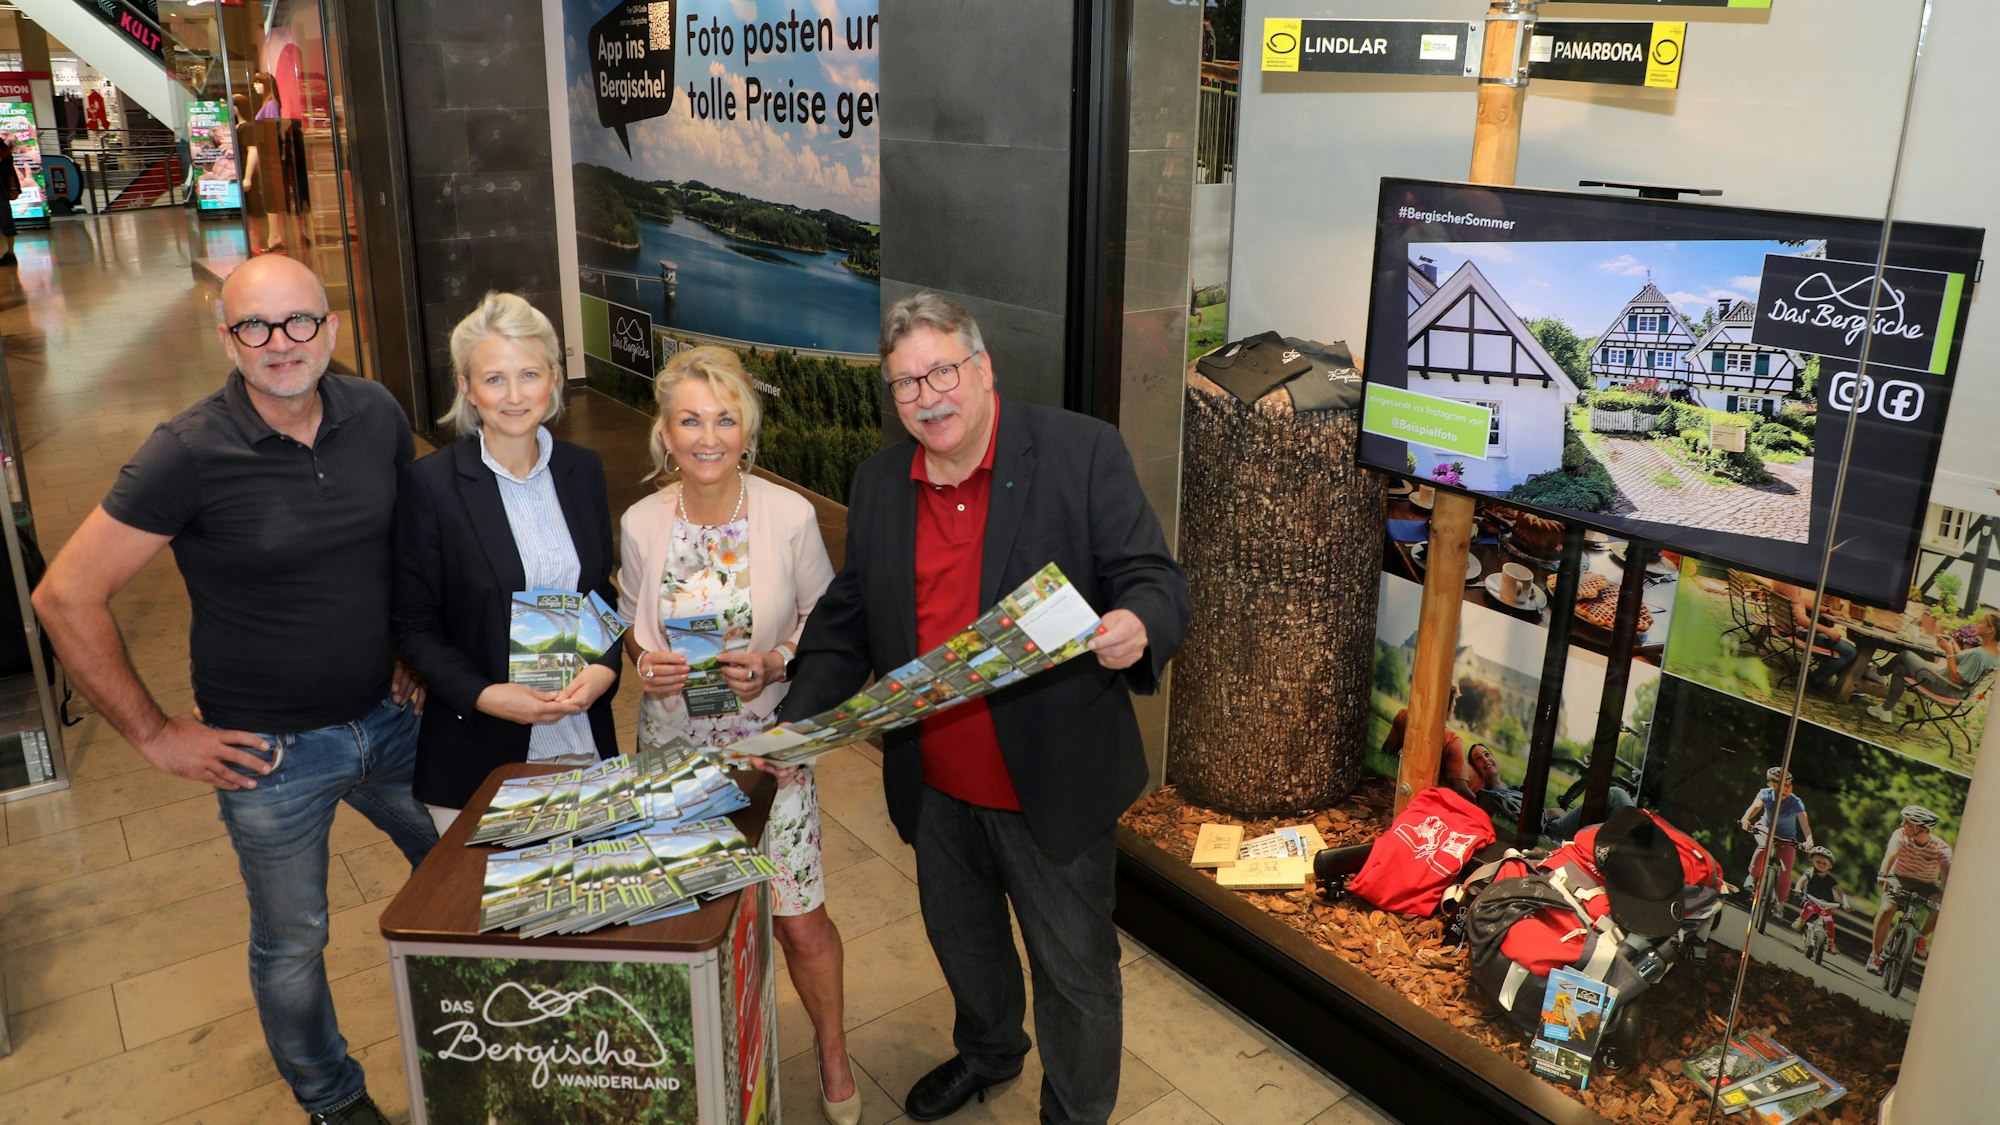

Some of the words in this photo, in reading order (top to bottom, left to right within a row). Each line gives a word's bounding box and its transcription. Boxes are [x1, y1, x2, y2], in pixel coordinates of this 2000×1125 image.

[121, 11, 160, 51] KULT
[687, 14, 734, 57] Foto
[743, 9, 833, 67] posten
[1305, 37, 1387, 55] LINDLAR
[597, 34, 622, 67] App
[626, 33, 645, 60] ins
[1554, 41, 1643, 62] PANARBORA
[600, 69, 666, 104] Bergische!
[688, 76, 736, 121] tolle
[746, 76, 826, 124] Preise
[1398, 206, 1516, 230] #BergischerSommer
[1768, 298, 1810, 325] Das
[1811, 303, 1923, 346] Bergische
[612, 333, 622, 350] Das
[623, 336, 650, 363] Bergische
[1370, 395, 1411, 410] eingesandt
[1414, 404, 1424, 413] via
[1426, 408, 1467, 423] Instagram
[1469, 417, 1484, 427] von
[1392, 417, 1457, 442] @Beispielfoto
[440, 999, 474, 1014] DAS
[433, 1019, 668, 1089] Bergische
[556, 1073, 680, 1091] WANDERLAND
